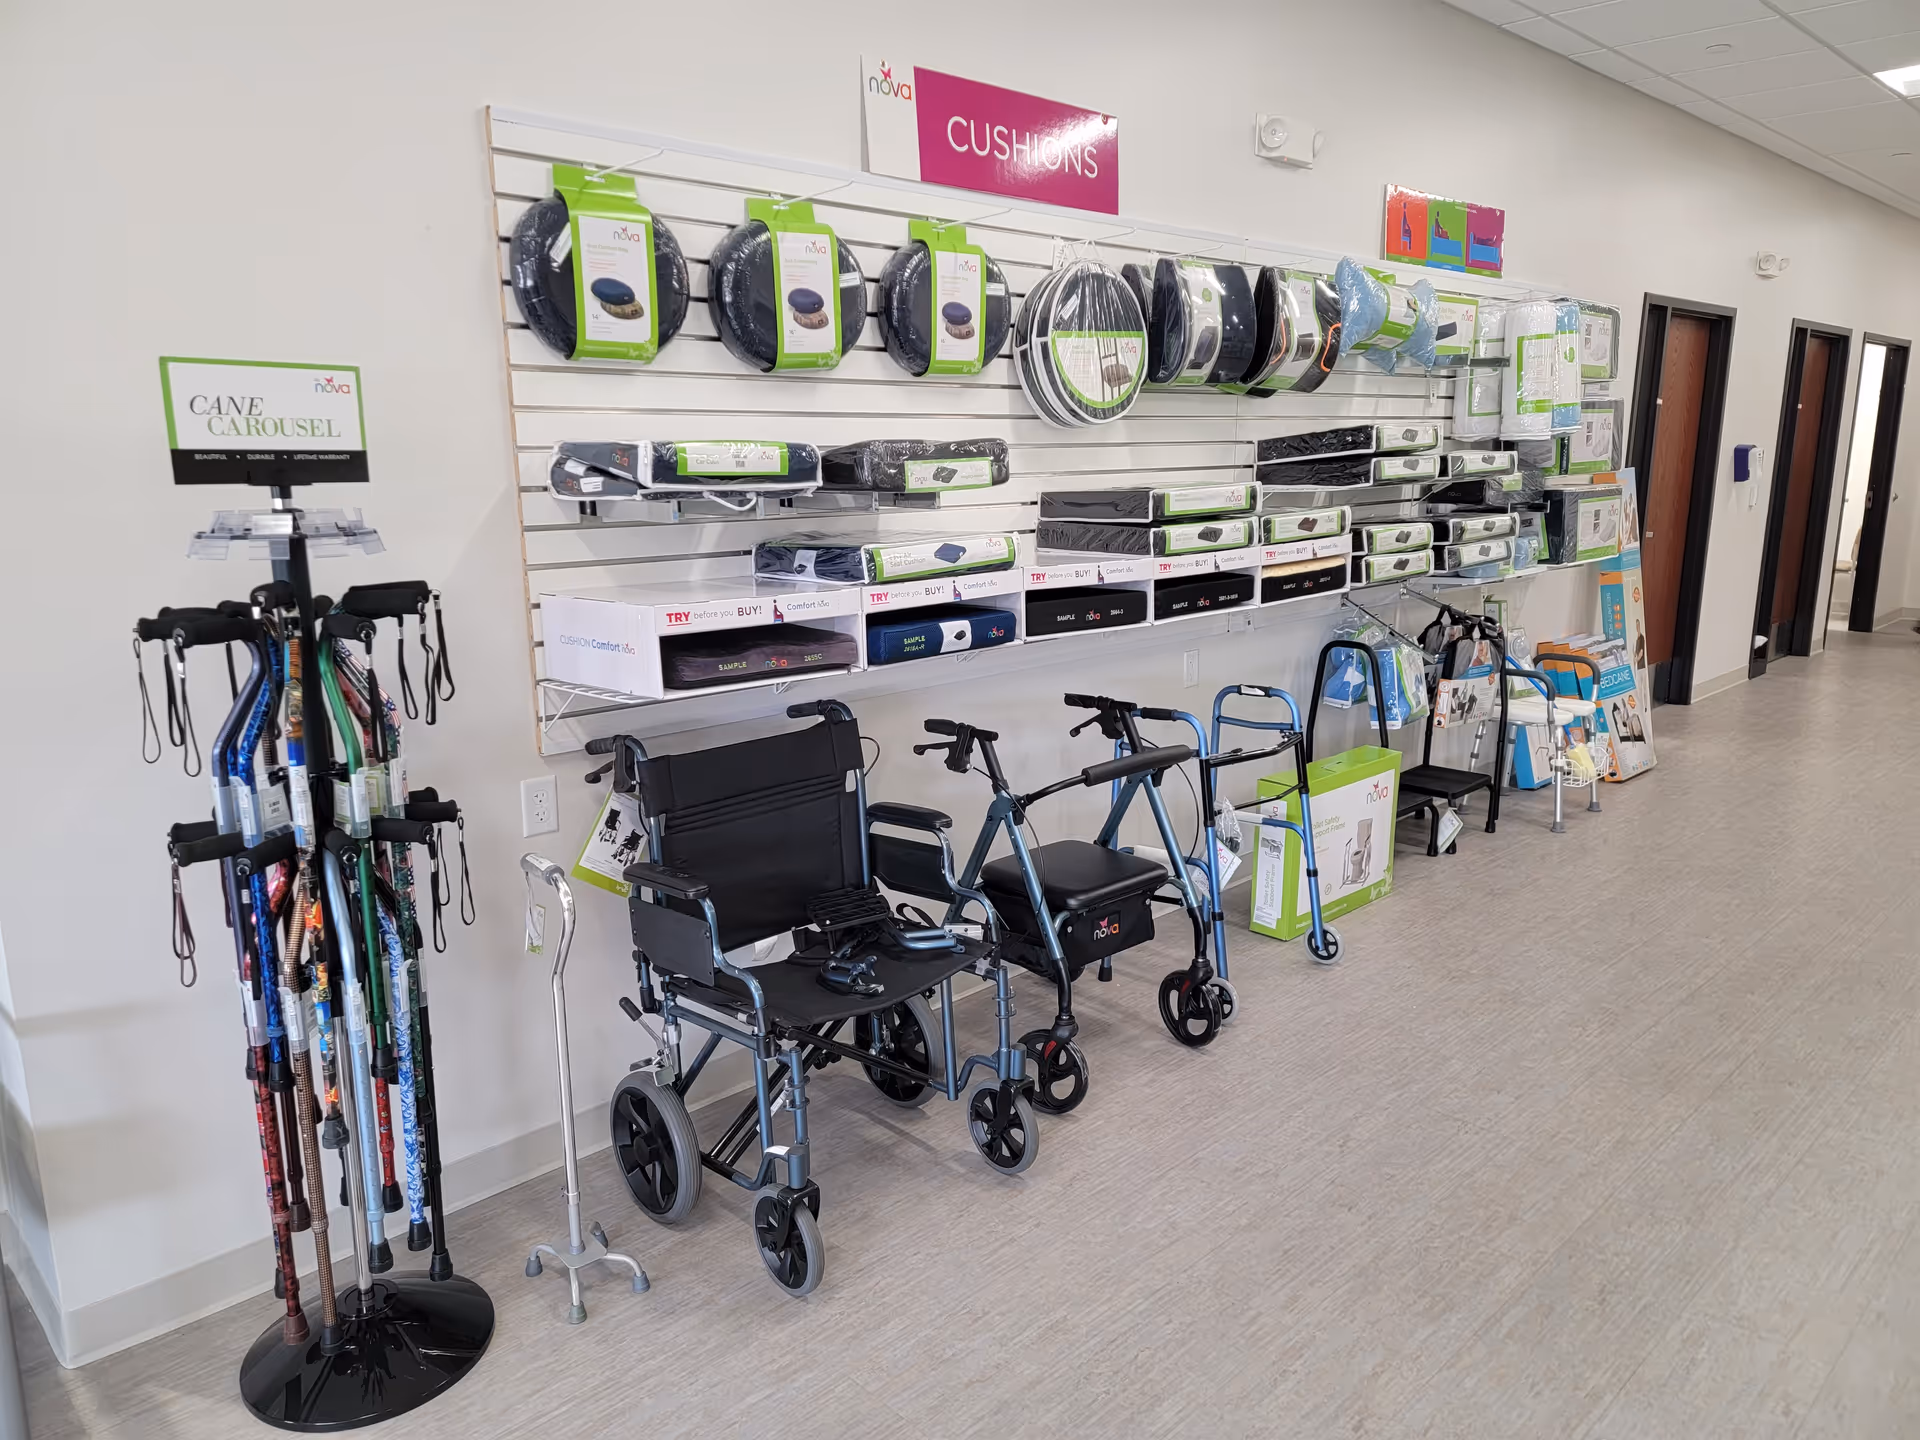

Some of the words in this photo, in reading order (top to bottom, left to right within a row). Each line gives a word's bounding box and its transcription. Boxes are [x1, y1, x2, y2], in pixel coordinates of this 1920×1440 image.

[868, 75, 912, 101] nova
[947, 115, 1098, 179] CUSHIONS
[613, 230, 640, 242] nova
[805, 244, 826, 255] nova
[959, 262, 977, 272] nova
[314, 381, 351, 394] nova
[189, 394, 264, 417] CANE
[207, 415, 342, 438] CAROUSEL
[1226, 494, 1242, 503] nova
[985, 540, 1001, 548] nova
[890, 560, 903, 568] Seat
[903, 557, 926, 566] Cushion
[1159, 563, 1172, 571] TRY
[1195, 559, 1209, 567] BUY!
[1031, 573, 1046, 581] TRY
[1075, 569, 1091, 578] BUY!
[1106, 567, 1125, 575] Comfort
[869, 592, 889, 602] TRY
[891, 590, 910, 598] before
[925, 586, 944, 596] BUY!
[963, 581, 987, 590] Comfort
[666, 611, 691, 623] TRY
[693, 610, 718, 619] before
[719, 609, 734, 618] you
[737, 605, 762, 616] BUY!
[786, 602, 816, 611] Comfort
[1086, 612, 1101, 620] nova
[560, 634, 591, 647] CUSHION
[591, 639, 621, 653] Comfort
[904, 635, 925, 644] SAMPLE
[988, 629, 1004, 638] nova
[718, 661, 747, 671] SAMPLE
[1600, 669, 1631, 689] BEDCANE
[1367, 785, 1388, 804] nova
[1325, 816, 1340, 826] Safety
[1094, 923, 1119, 940] nova
